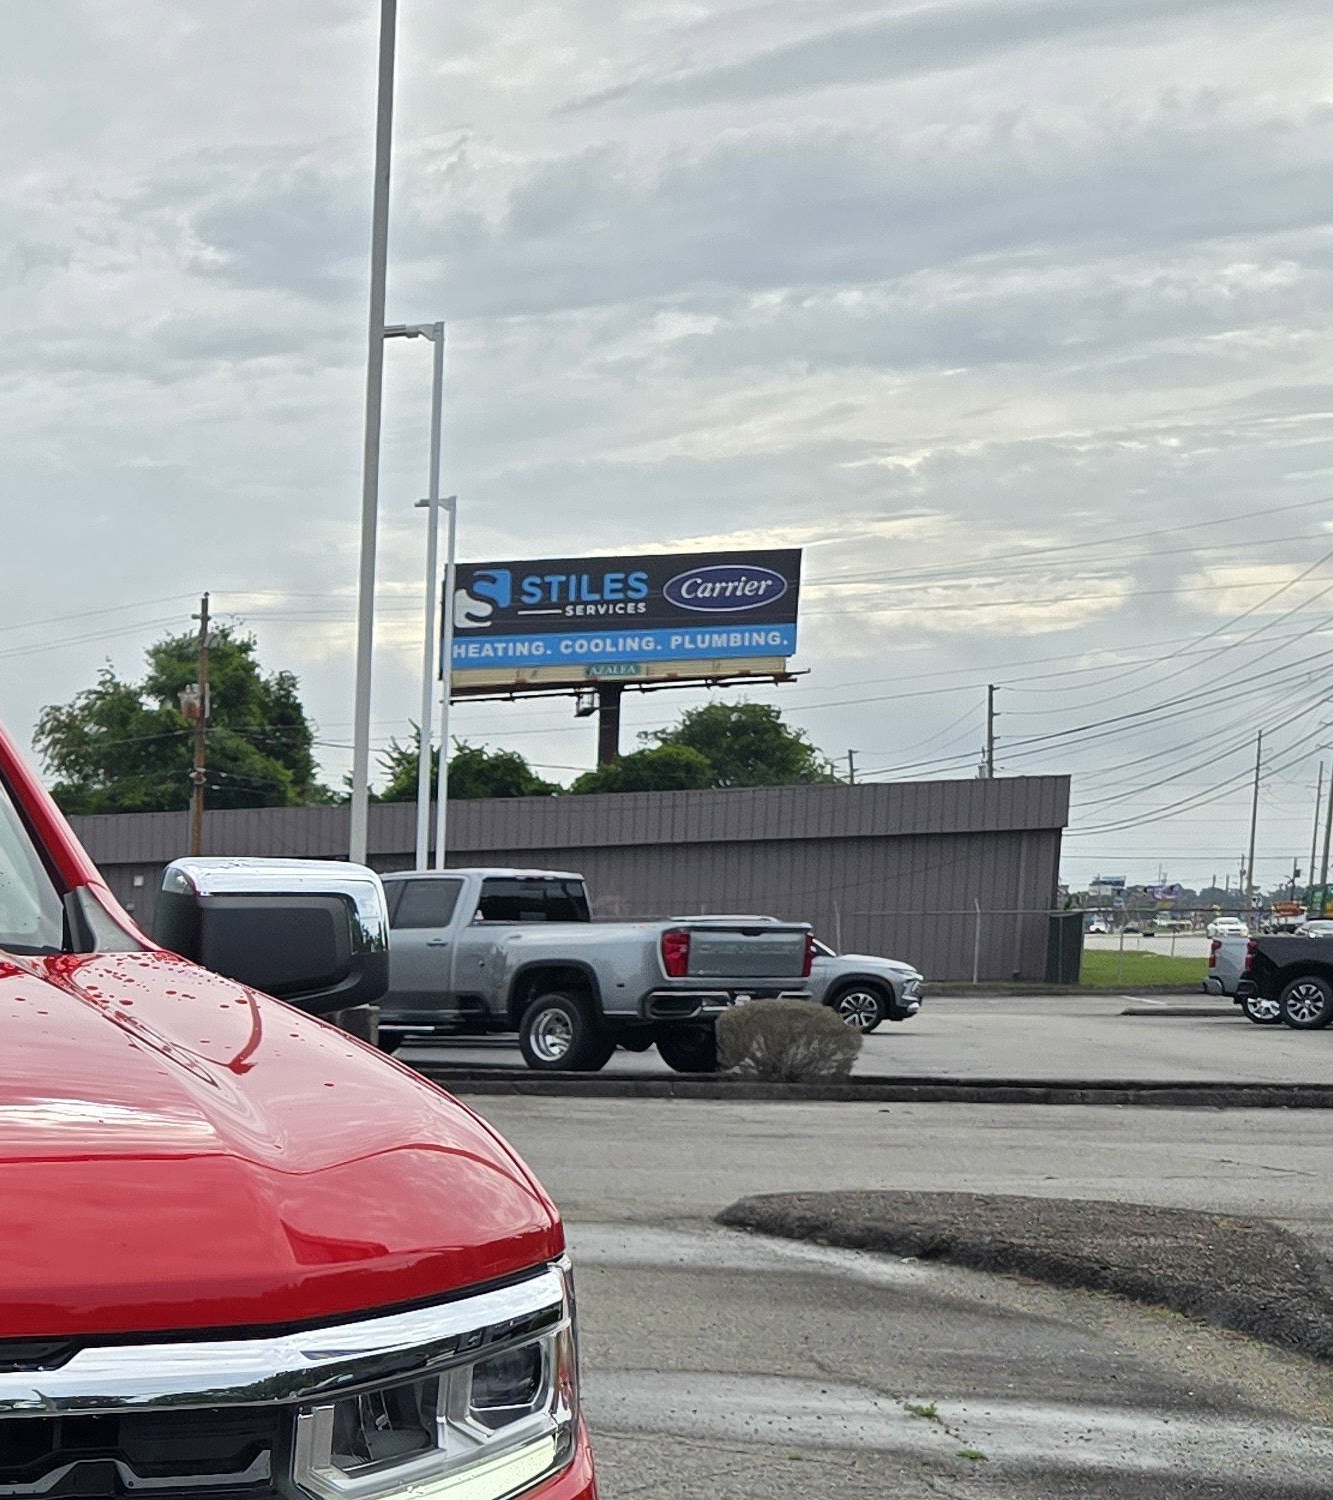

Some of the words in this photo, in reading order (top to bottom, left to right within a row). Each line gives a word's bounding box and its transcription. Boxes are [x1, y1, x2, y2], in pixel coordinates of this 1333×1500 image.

[520, 572, 648, 603] STILES
[681, 576, 773, 599] Carrier
[564, 602, 646, 617] SERVICES
[452, 641, 552, 659] HEATING.
[560, 637, 662, 655] COOLING.
[671, 631, 788, 650] PLUMBING.
